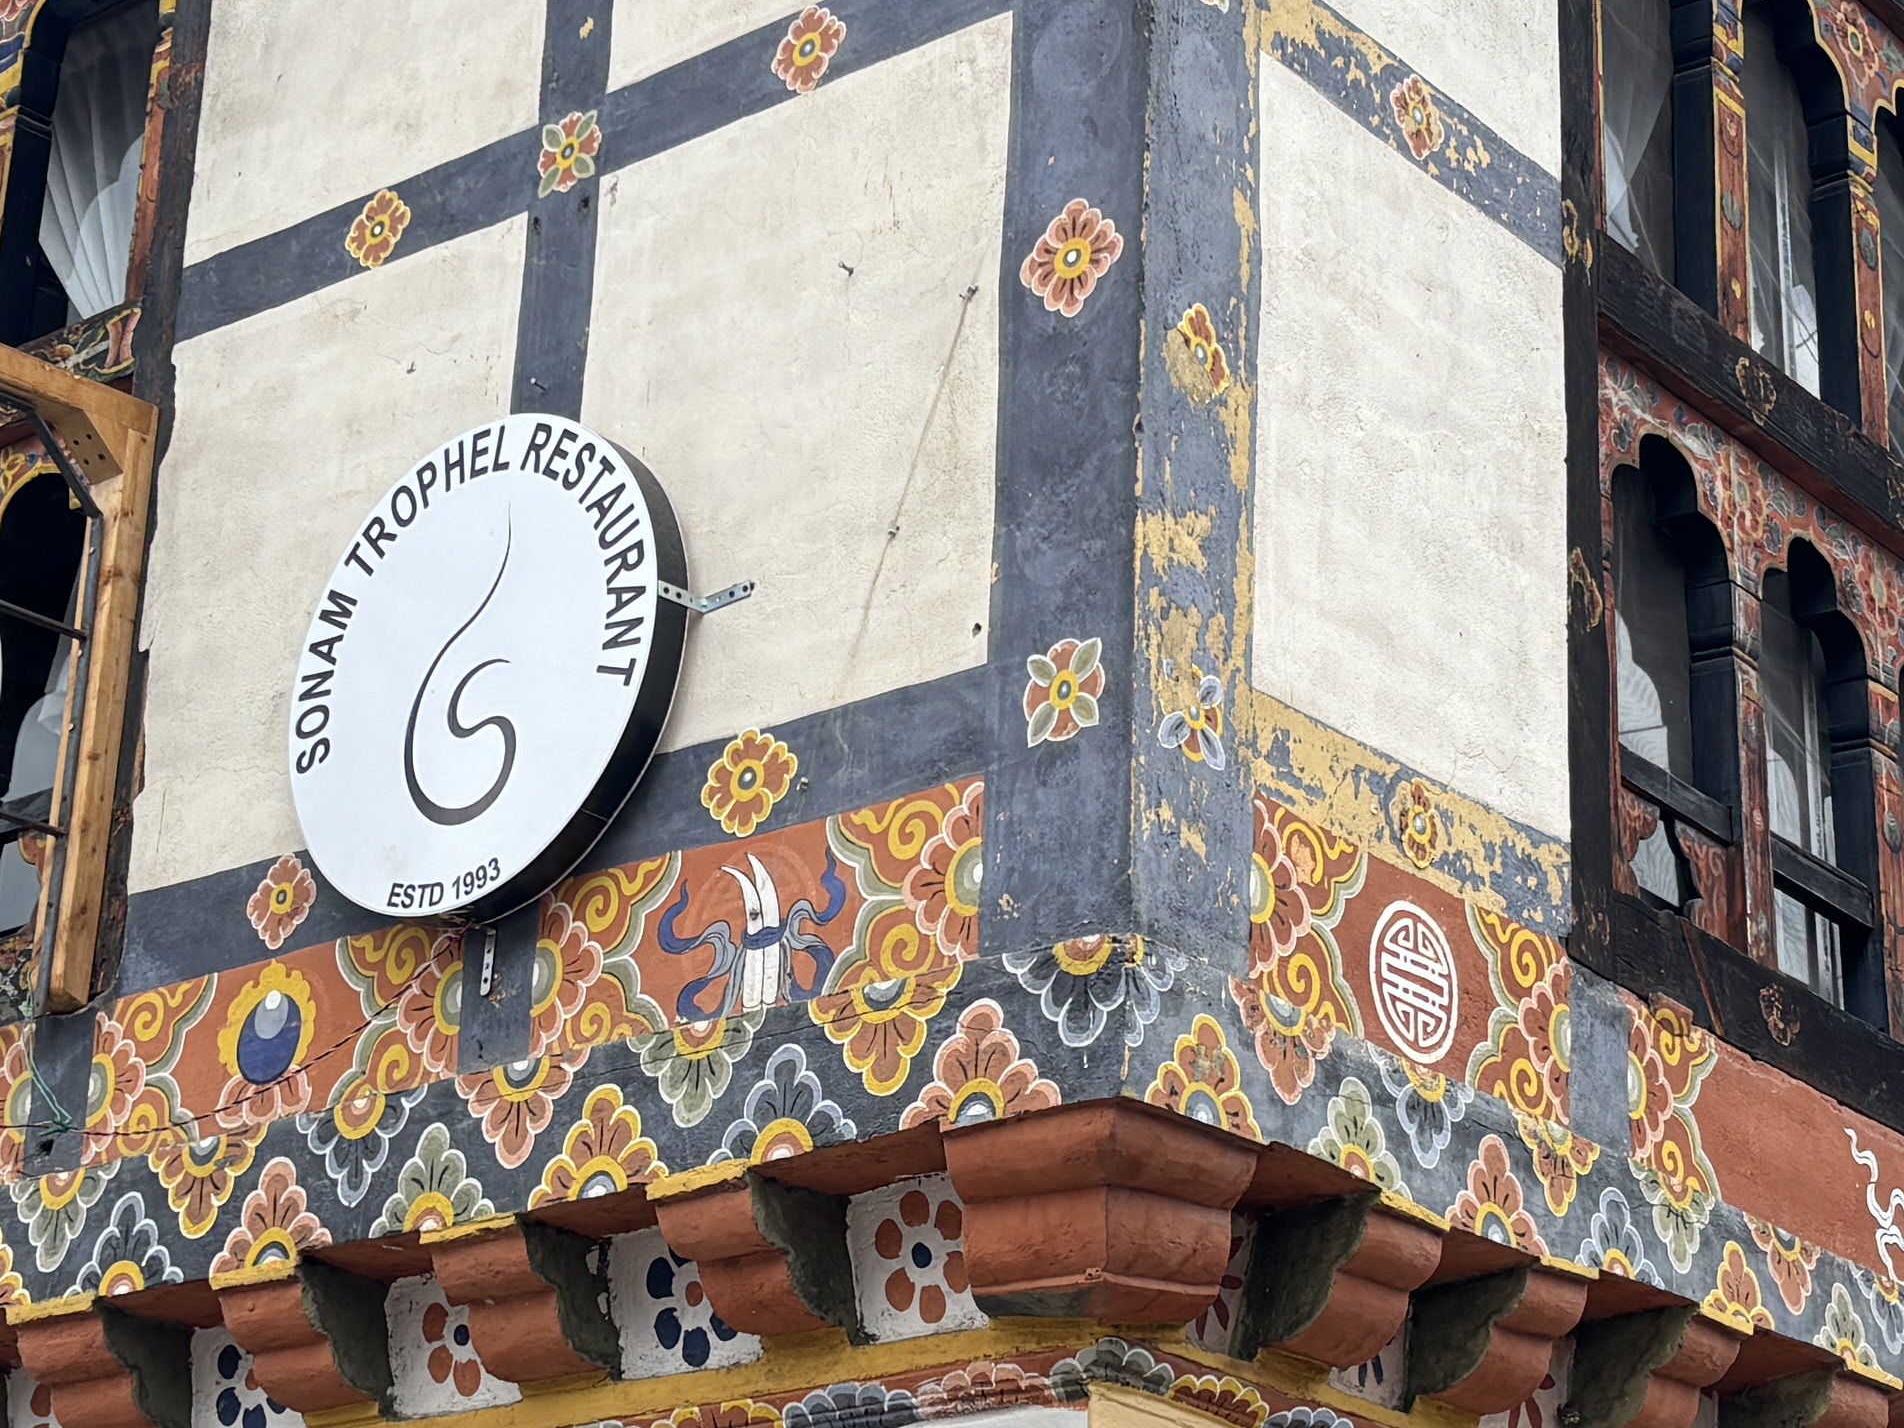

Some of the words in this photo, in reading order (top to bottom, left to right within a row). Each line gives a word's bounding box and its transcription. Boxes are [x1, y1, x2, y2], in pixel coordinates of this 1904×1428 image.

[296, 588, 358, 775] SONAM
[344, 424, 511, 577] TROPHEL
[520, 422, 647, 687] RESTAURANT
[387, 882, 444, 910] ESTD
[452, 857, 501, 902] 1993
